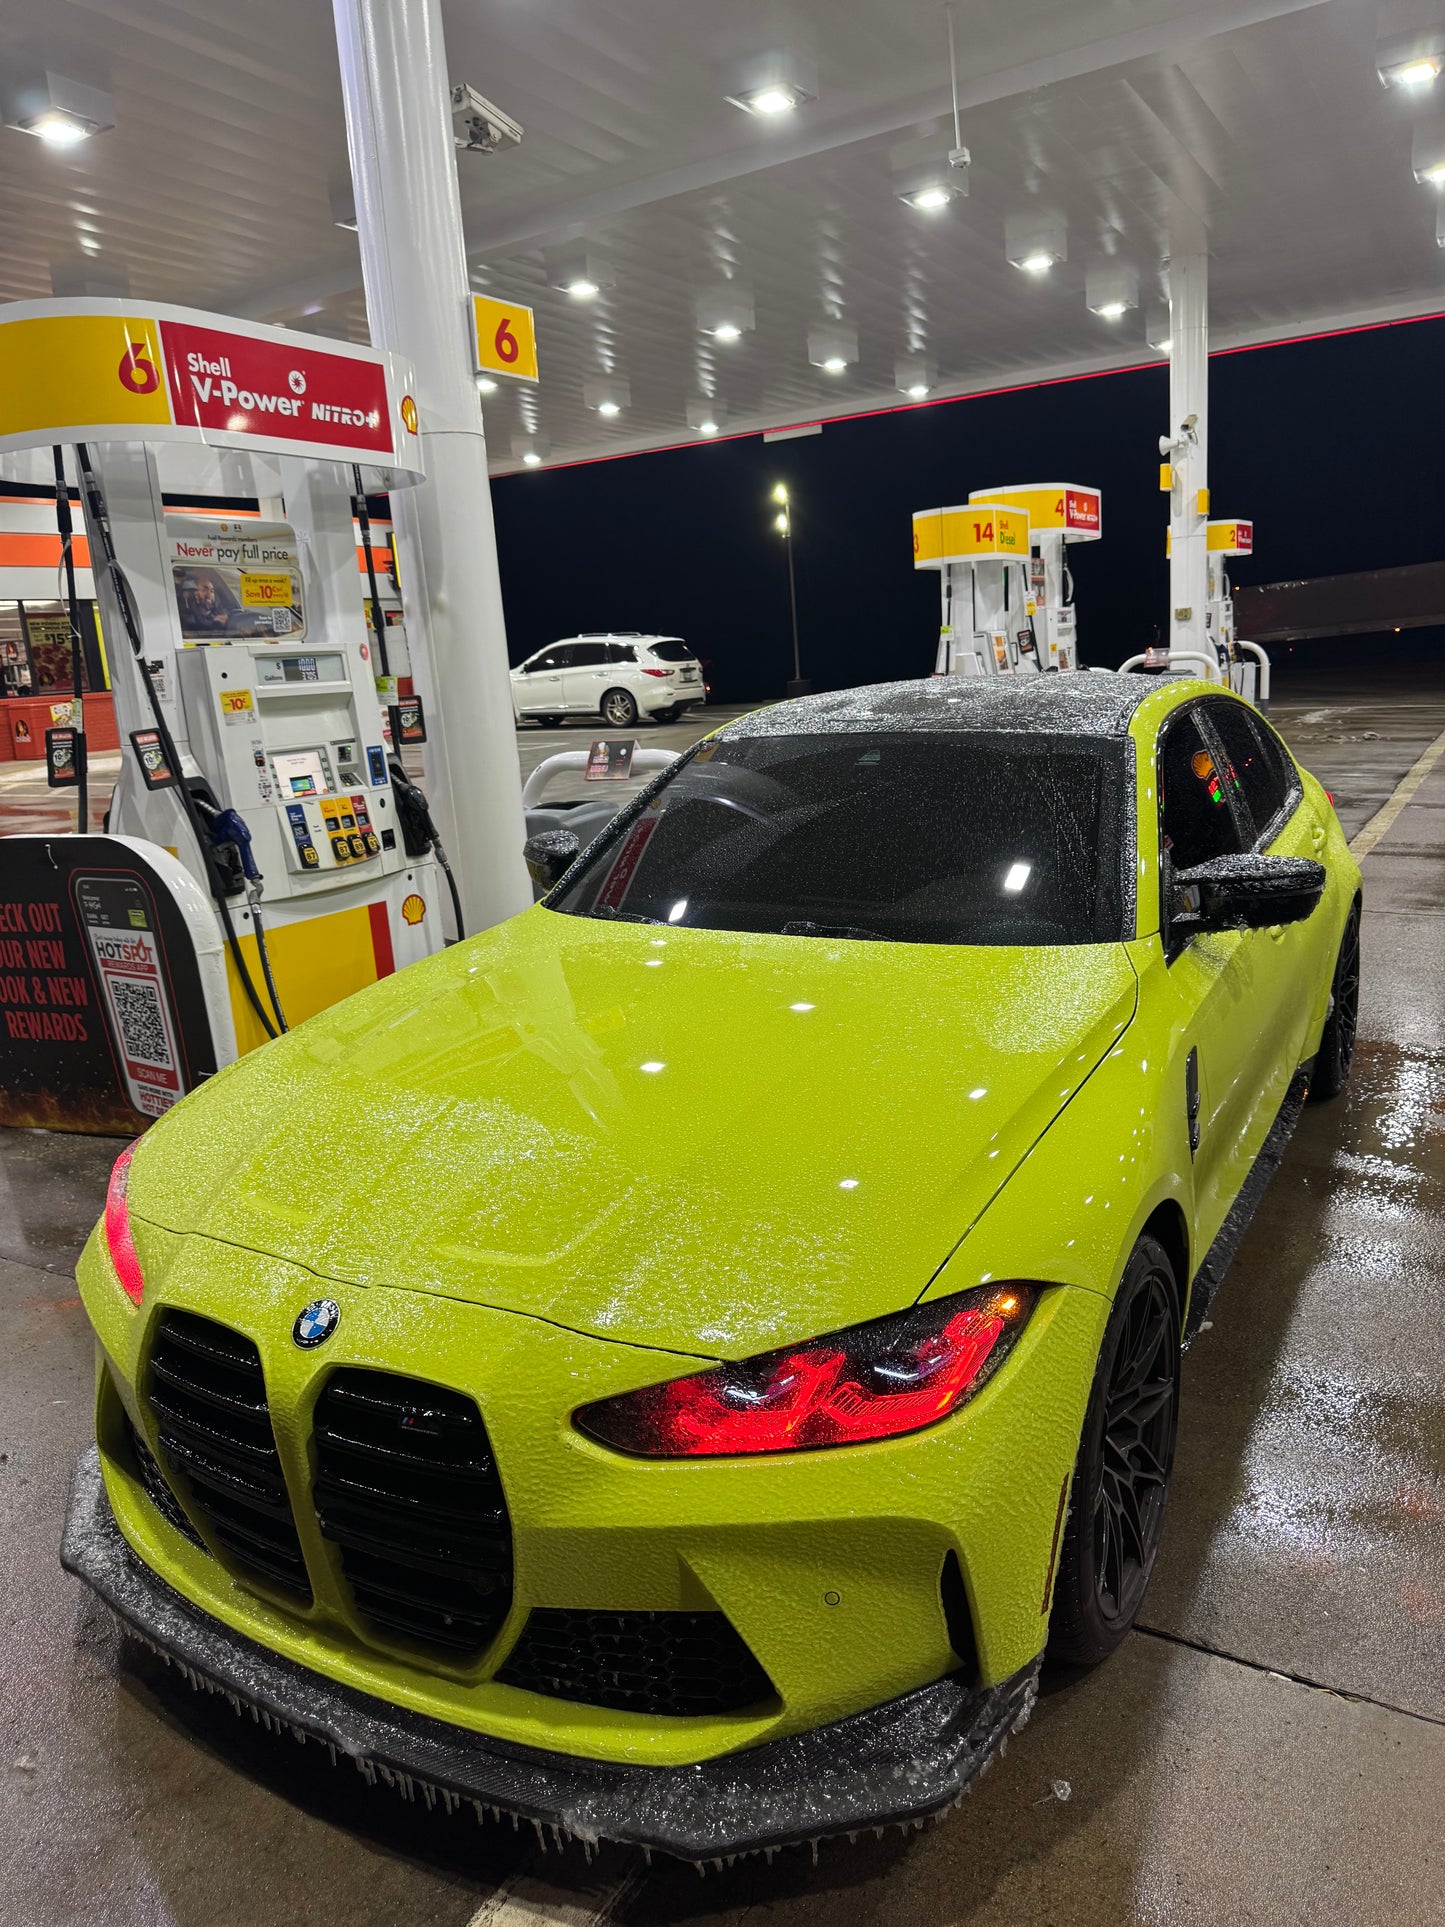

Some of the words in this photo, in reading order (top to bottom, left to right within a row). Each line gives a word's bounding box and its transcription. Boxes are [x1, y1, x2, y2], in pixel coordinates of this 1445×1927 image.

[495, 318, 519, 363] 6
[118, 343, 161, 394] 6
[187, 352, 232, 378] Shell
[190, 374, 303, 417] V-Power
[1055, 498, 1065, 517] 4
[973, 522, 994, 543] 14
[1000, 531, 1016, 546] Diesel
[1230, 529, 1236, 542] 2
[176, 542, 214, 558] Never
[217, 547, 240, 562] pay
[242, 544, 260, 559] full
[262, 546, 288, 563] price
[28, 902, 63, 932] OUT
[0, 940, 27, 969] UR
[25, 940, 66, 969] NEW
[95, 936, 153, 963] HOTSPOT
[31, 976, 48, 1005] &
[46, 976, 88, 1006] NEW
[4, 1010, 88, 1041] REWARDS
[136, 1067, 156, 1081] SCAN
